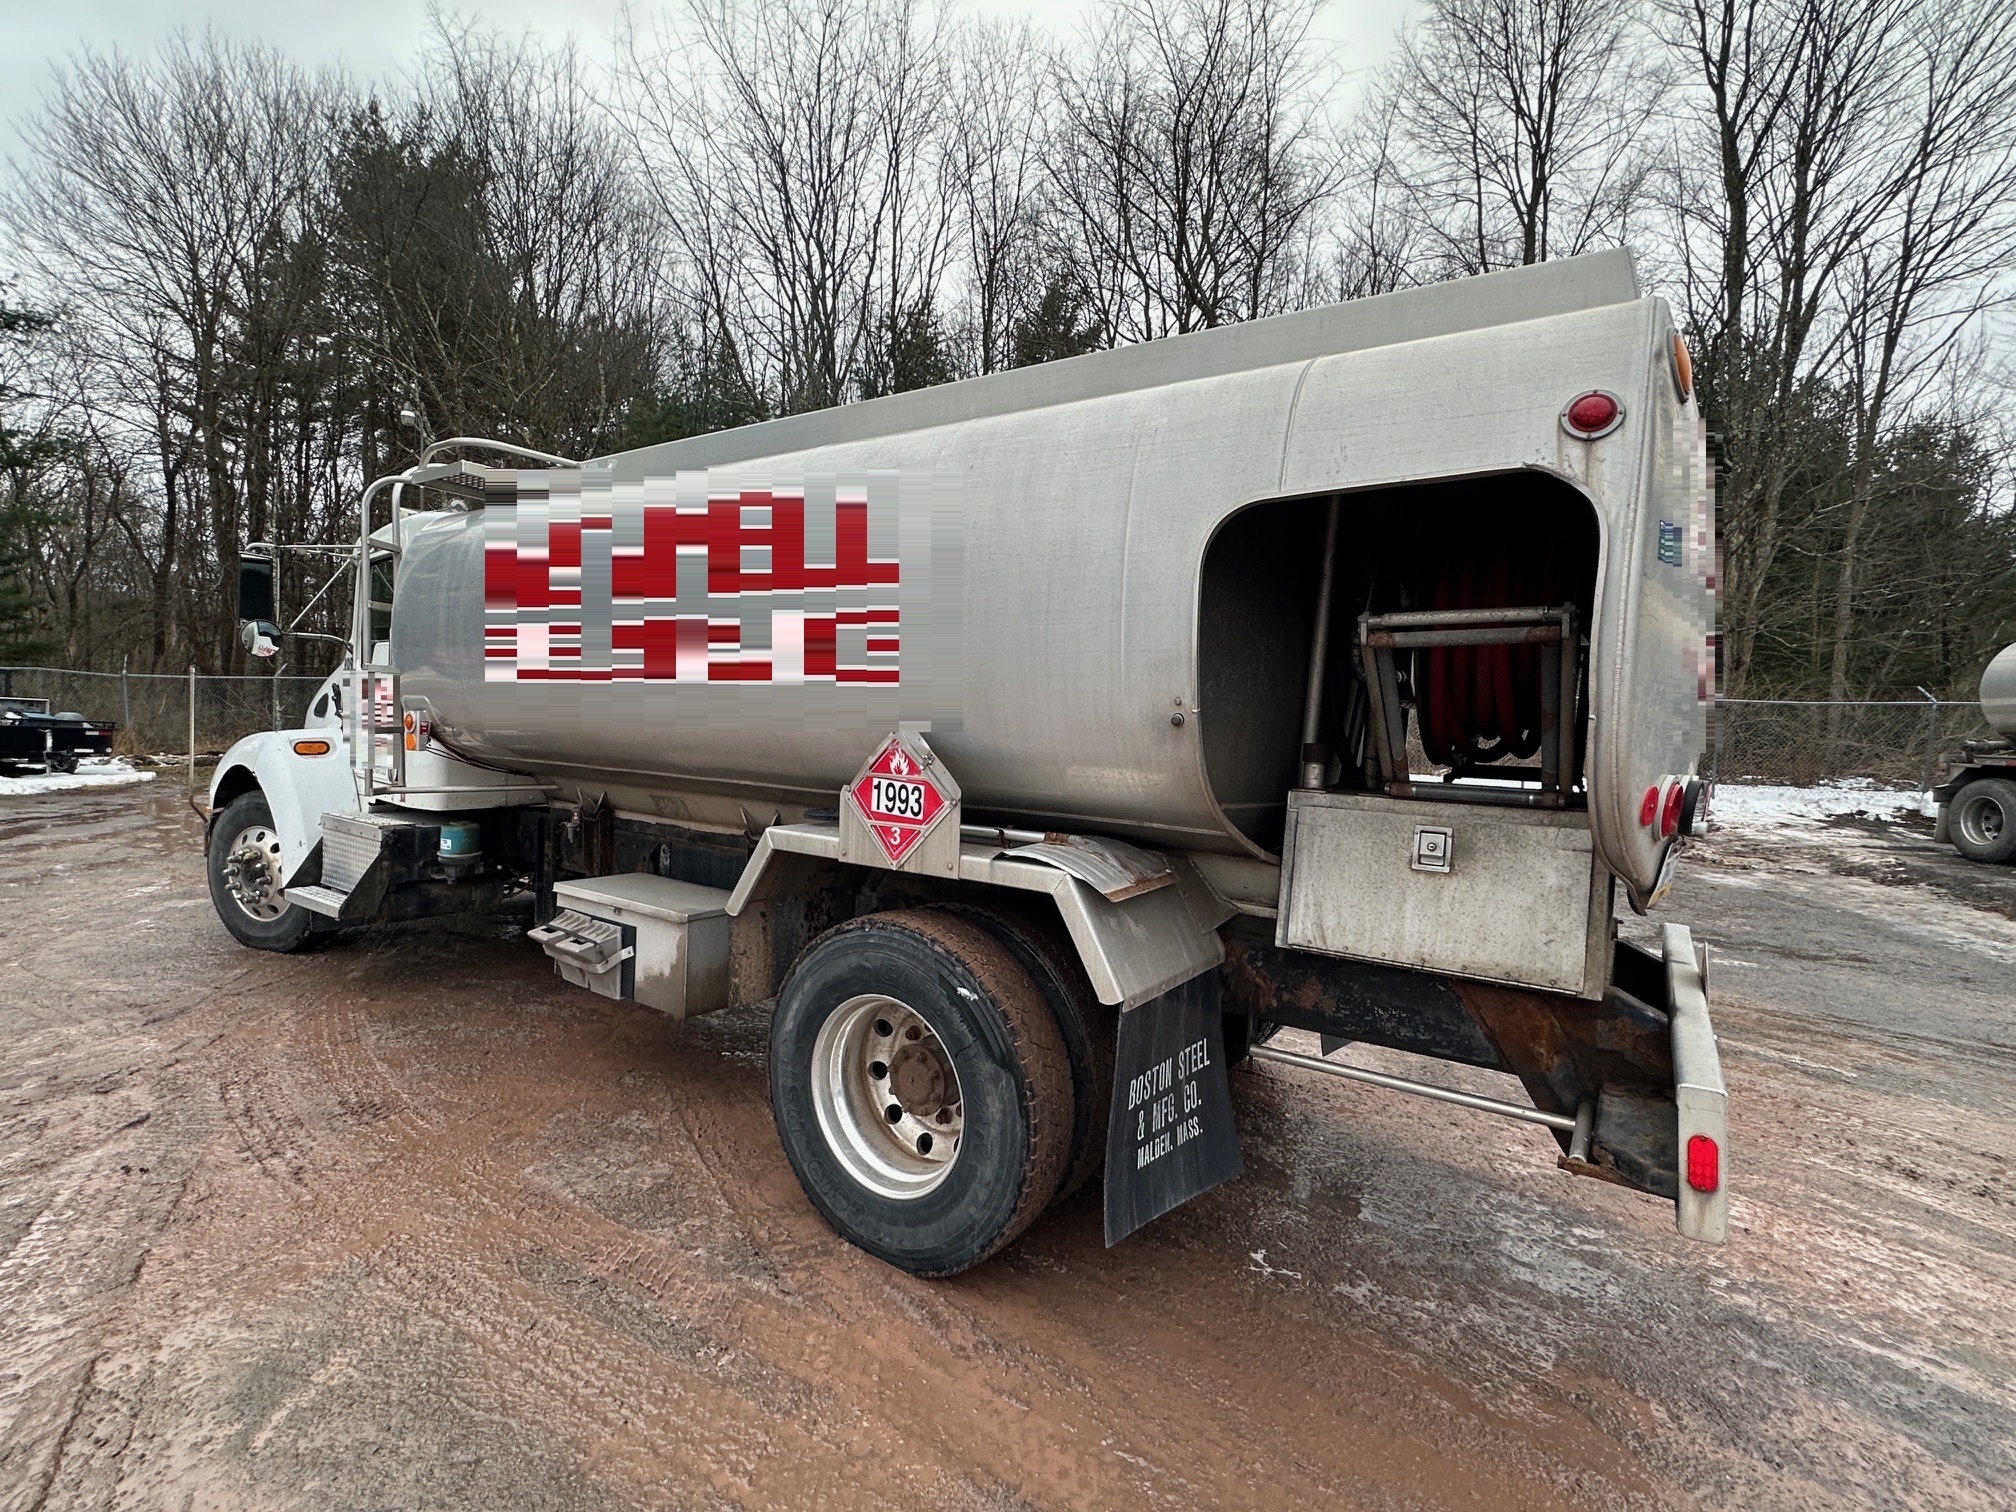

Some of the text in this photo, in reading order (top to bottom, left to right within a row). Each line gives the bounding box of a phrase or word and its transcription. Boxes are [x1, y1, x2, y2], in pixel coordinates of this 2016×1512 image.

[874, 780, 922, 817] 1993
[890, 826, 901, 845] 3
[1128, 1038, 1211, 1111] BOSTON STEEL
[1137, 1080, 1202, 1141] & MFG. CO.
[1176, 1116, 1203, 1147] MASS.
